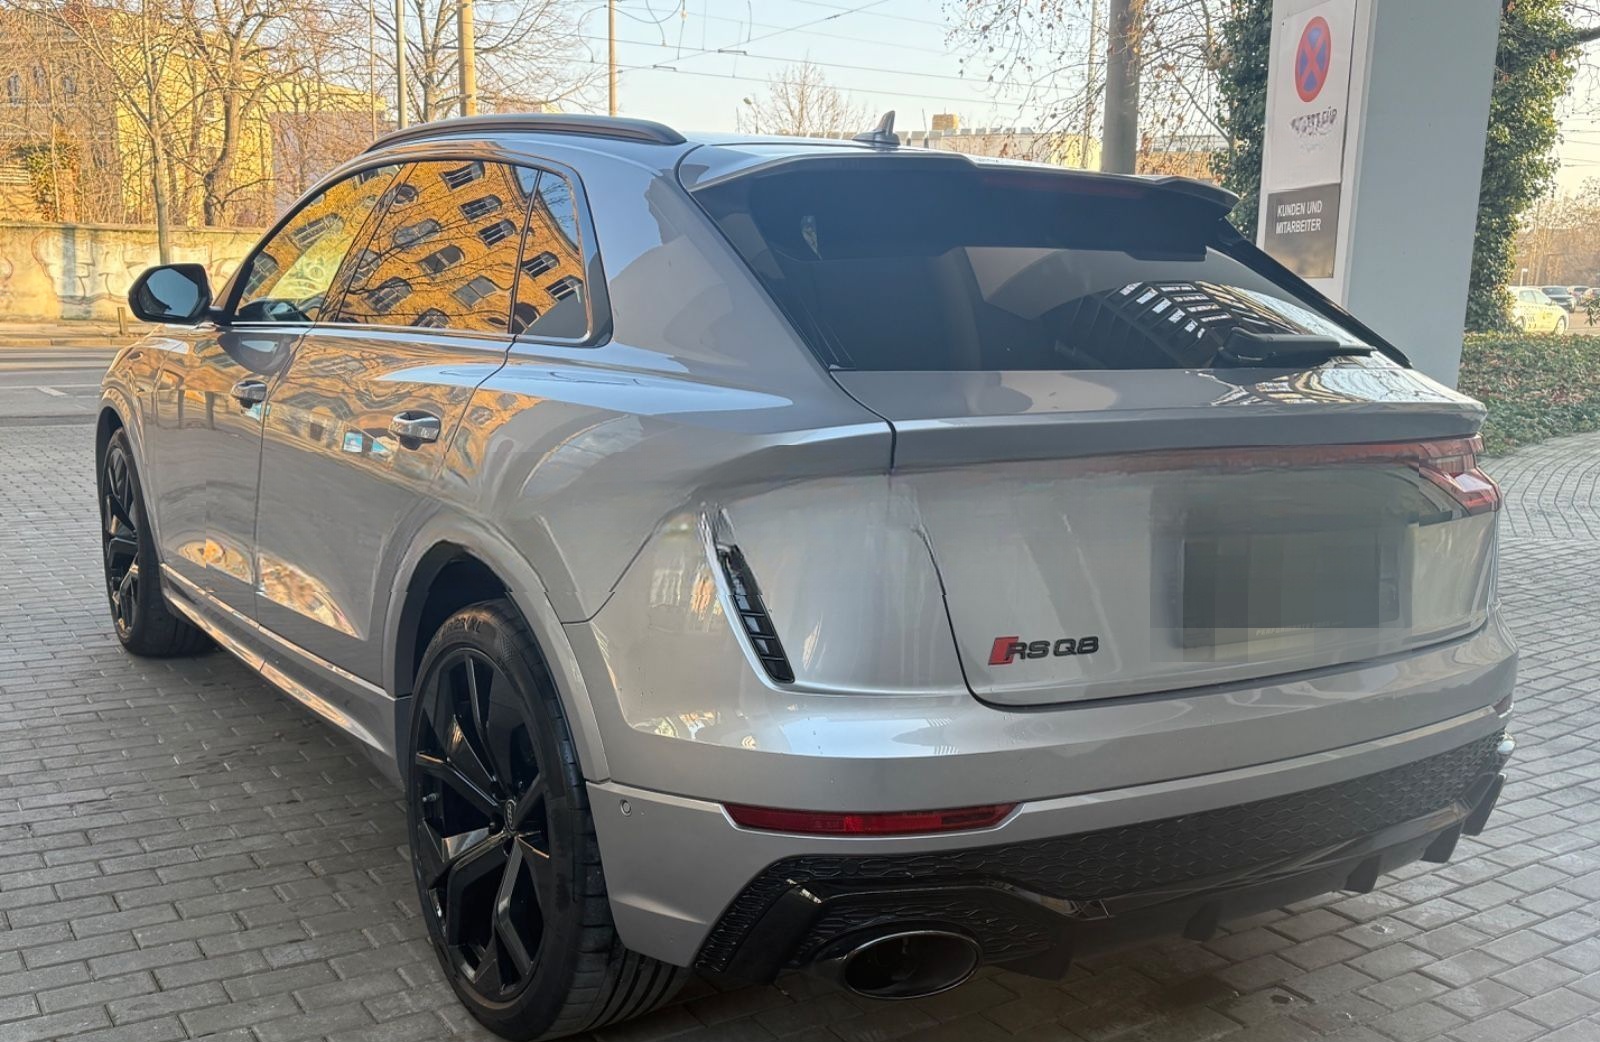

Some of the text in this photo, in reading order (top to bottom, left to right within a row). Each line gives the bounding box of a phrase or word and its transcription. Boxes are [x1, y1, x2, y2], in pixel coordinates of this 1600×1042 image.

[1277, 200, 1322, 217] KUNDEN UND
[1276, 219, 1321, 234] MITARBEITER
